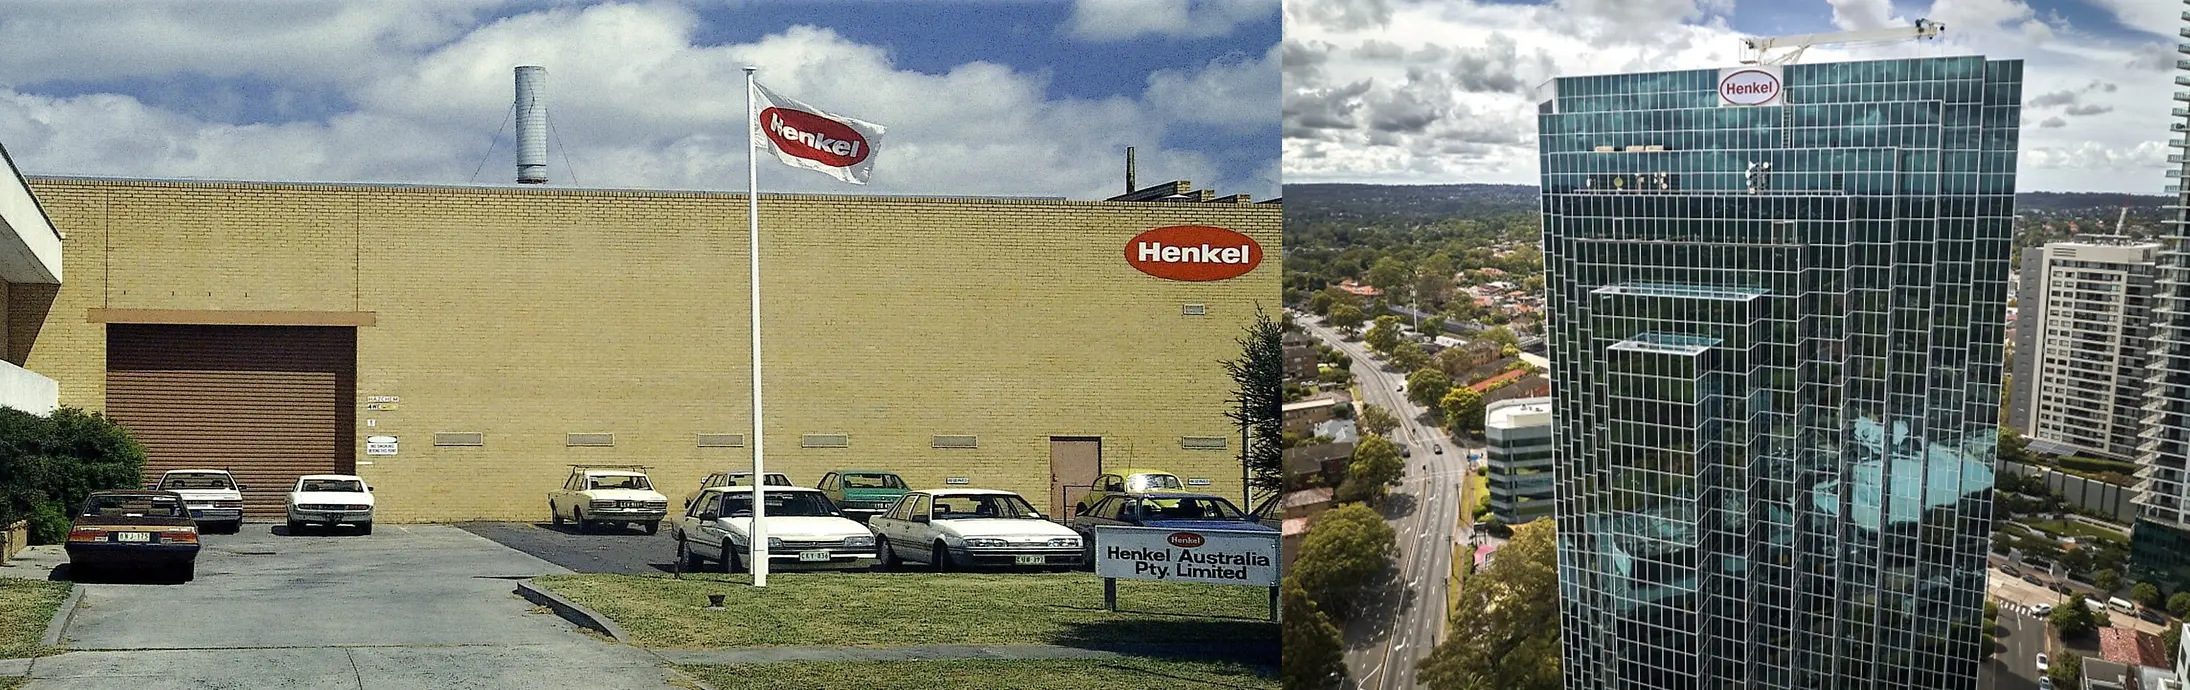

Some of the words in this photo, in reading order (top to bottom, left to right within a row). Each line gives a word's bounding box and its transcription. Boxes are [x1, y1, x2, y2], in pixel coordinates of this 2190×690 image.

[1726, 81, 1772, 95] Henkel
[770, 112, 860, 158] Henkel
[1138, 241, 1249, 264] Henkel
[1171, 535, 1201, 544] Henkel
[1107, 546, 1170, 562] Henkel
[1178, 549, 1270, 566] Australia
[1135, 561, 1170, 579] Pty.
[1177, 563, 1247, 580] Limited
